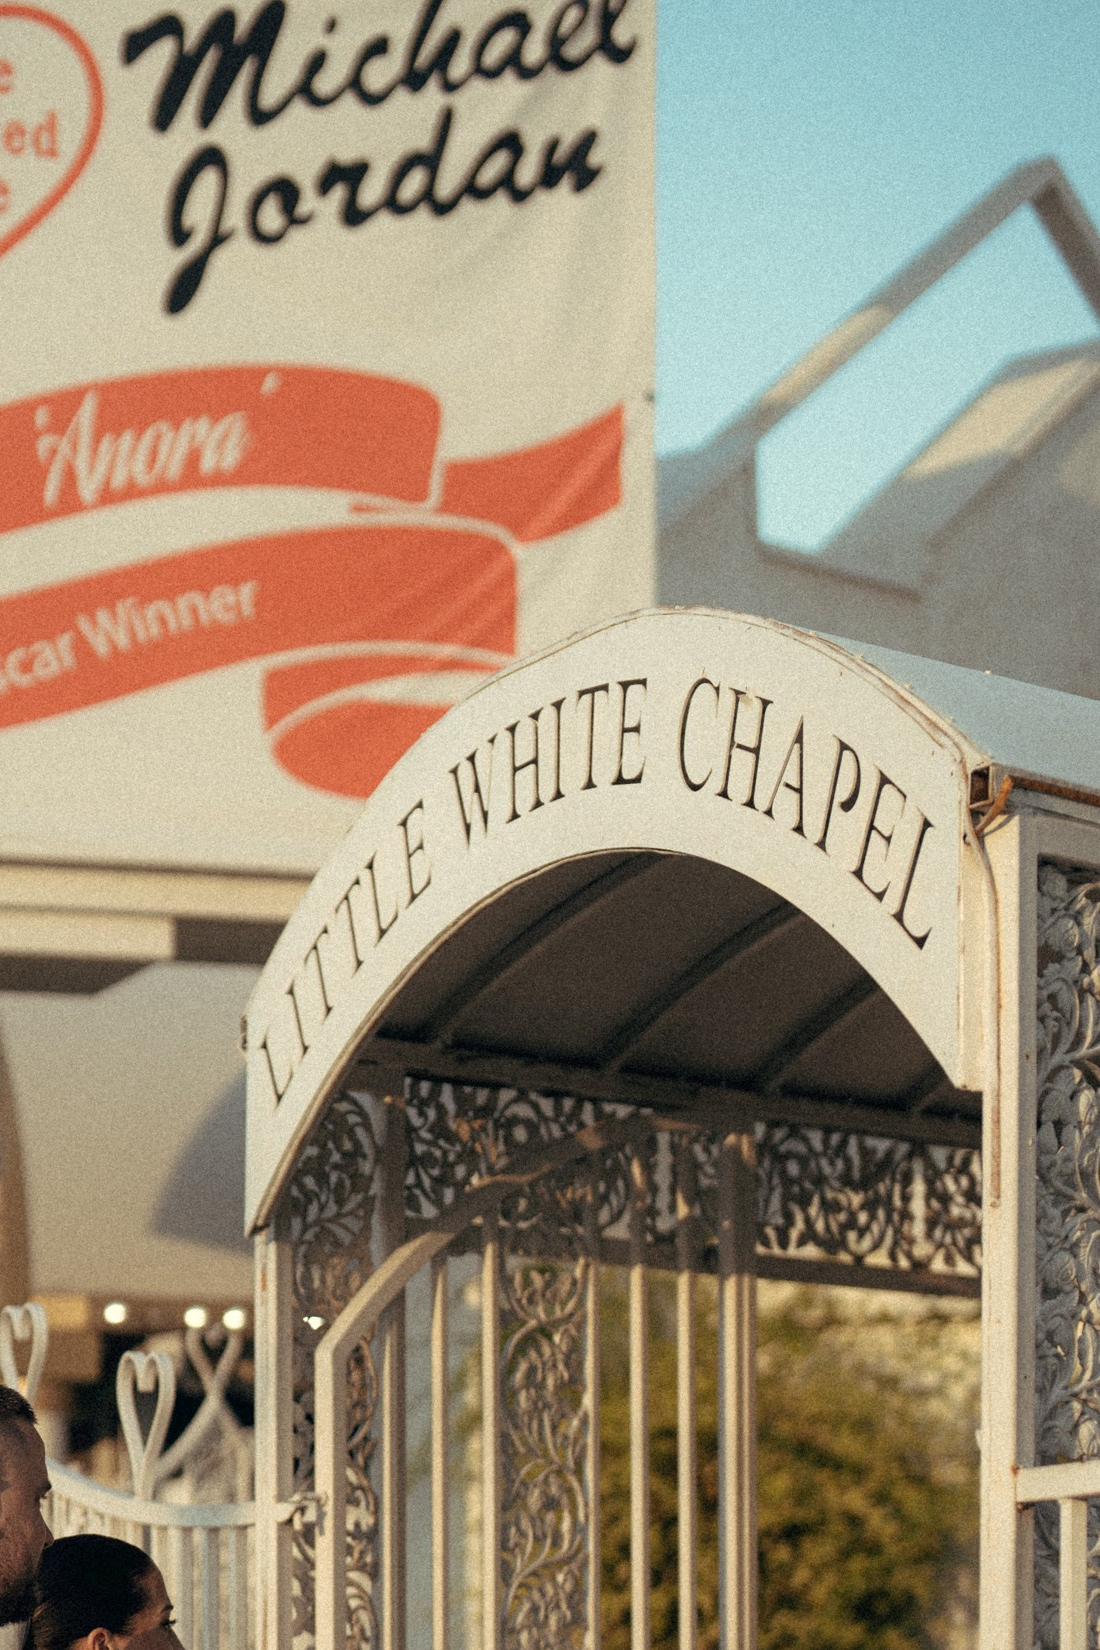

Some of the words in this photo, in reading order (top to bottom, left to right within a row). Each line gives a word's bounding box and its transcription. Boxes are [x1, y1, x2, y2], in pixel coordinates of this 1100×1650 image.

[122, 0, 638, 134] Michael
[165, 105, 603, 316] Jordan
[77, 580, 259, 659] Winner
[258, 798, 433, 1110] LITTLE
[448, 676, 649, 851] WHITE
[677, 676, 937, 950] CHAPEL
